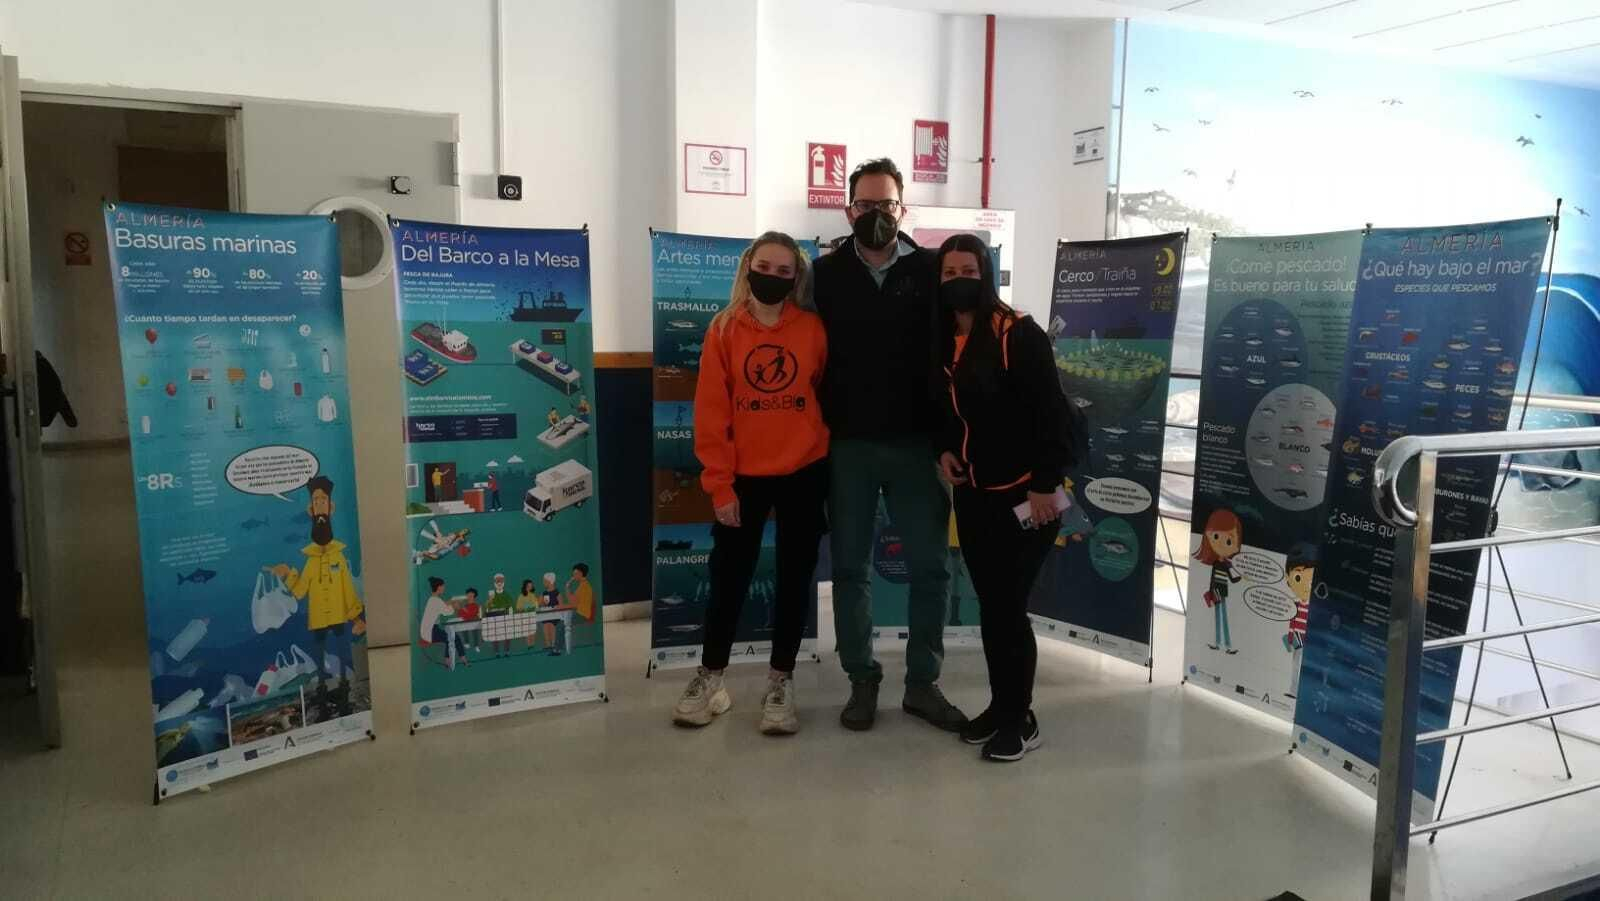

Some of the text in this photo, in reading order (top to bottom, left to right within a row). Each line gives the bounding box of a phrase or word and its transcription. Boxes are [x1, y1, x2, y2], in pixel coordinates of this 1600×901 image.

[809, 194, 845, 204] EXTINTOR
[115, 228, 297, 255] Basuras marinas
[401, 245, 580, 268] Del Barco a la Mesa
[656, 249, 741, 267] Artes men
[1276, 256, 1347, 276] pescado!
[1362, 252, 1542, 280] ¿Qué hay bajo el mar?
[1058, 270, 1094, 283] Cerco
[1213, 278, 1227, 291] Es
[1231, 279, 1269, 292] bueno
[1273, 281, 1303, 294] para
[1305, 279, 1318, 292] tu
[1394, 283, 1496, 293] ESPECIES QUE PESCAMOS
[657, 302, 719, 312] TRASMALLO
[1247, 355, 1266, 364] AZUL
[1455, 384, 1480, 394] PECES
[1203, 422, 1236, 435] Pescado
[657, 430, 692, 440] NASAS
[1202, 434, 1229, 445] blanco
[1279, 442, 1310, 453] BLANCO
